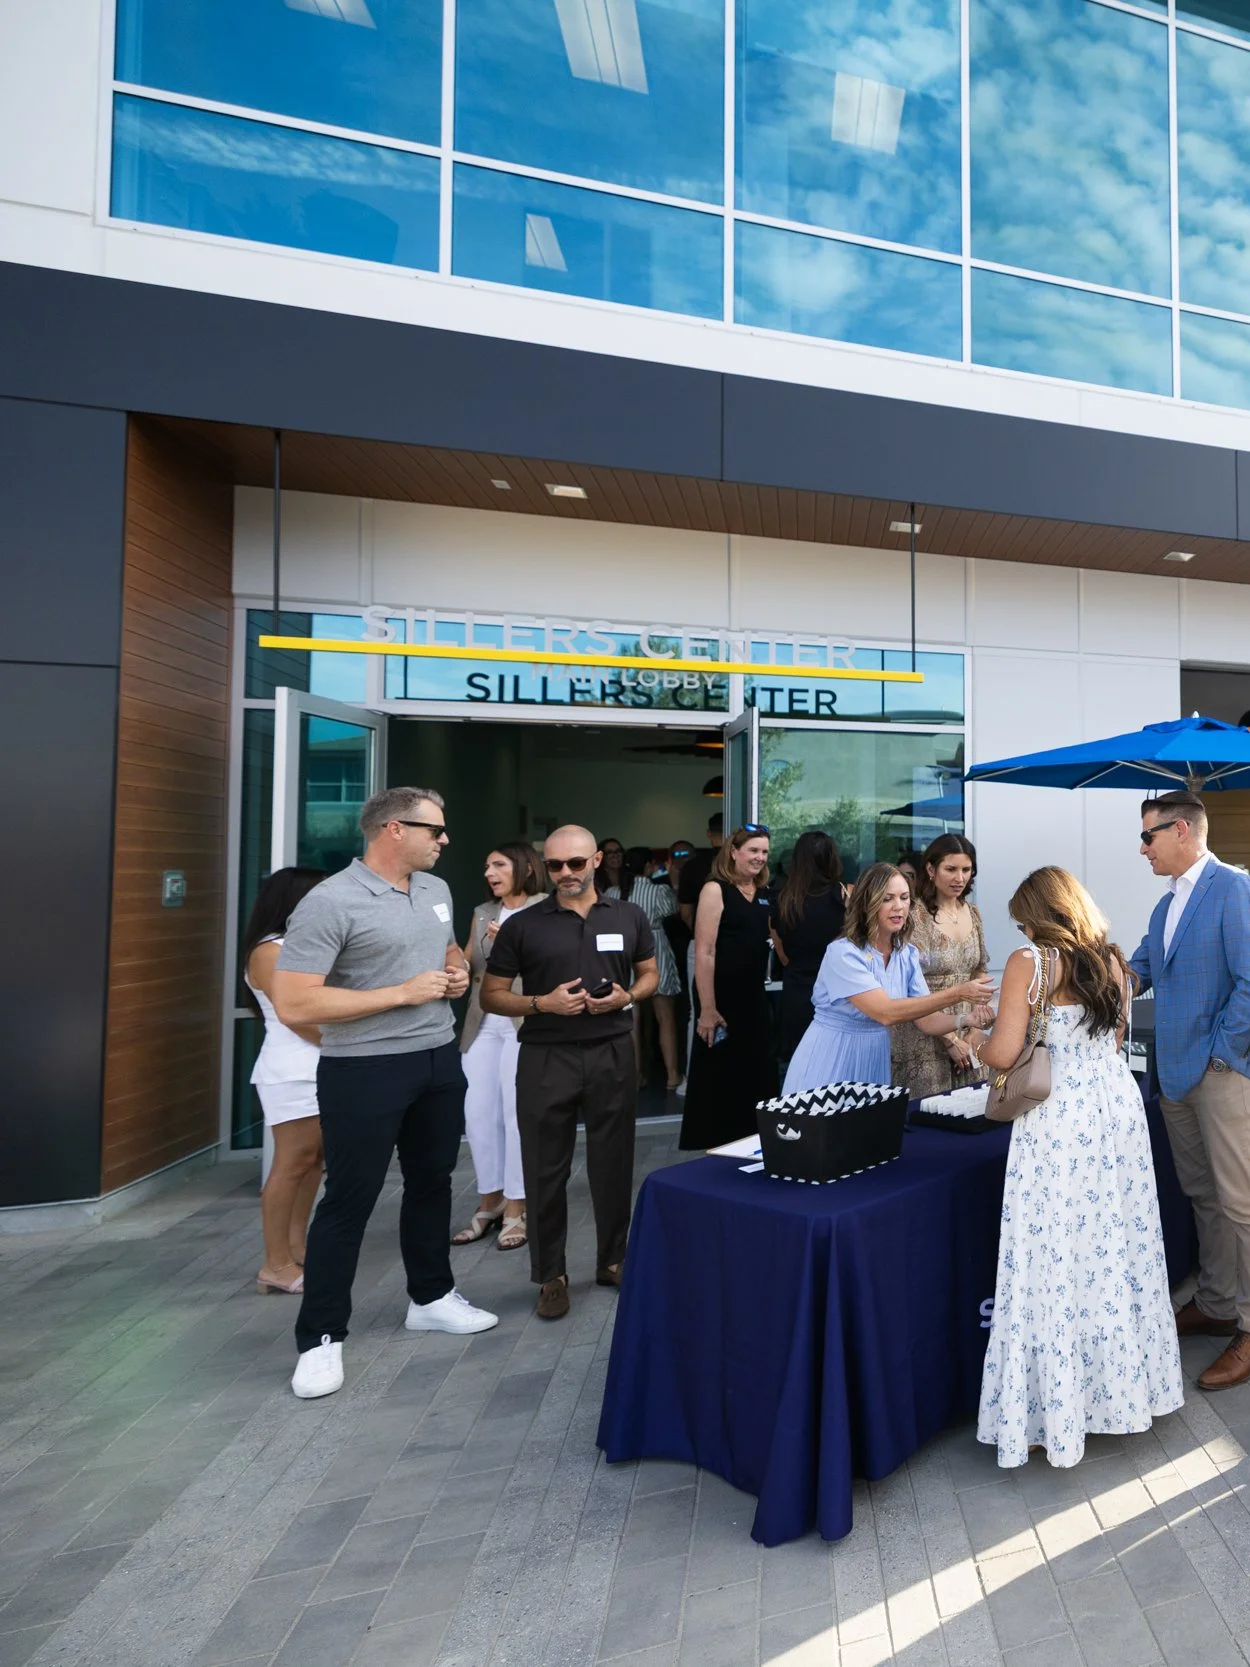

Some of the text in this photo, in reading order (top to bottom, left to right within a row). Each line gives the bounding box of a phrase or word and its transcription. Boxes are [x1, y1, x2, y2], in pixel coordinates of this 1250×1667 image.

[361, 605, 857, 669] SILLERS CENTER
[531, 663, 718, 690] MAIN LOBBY
